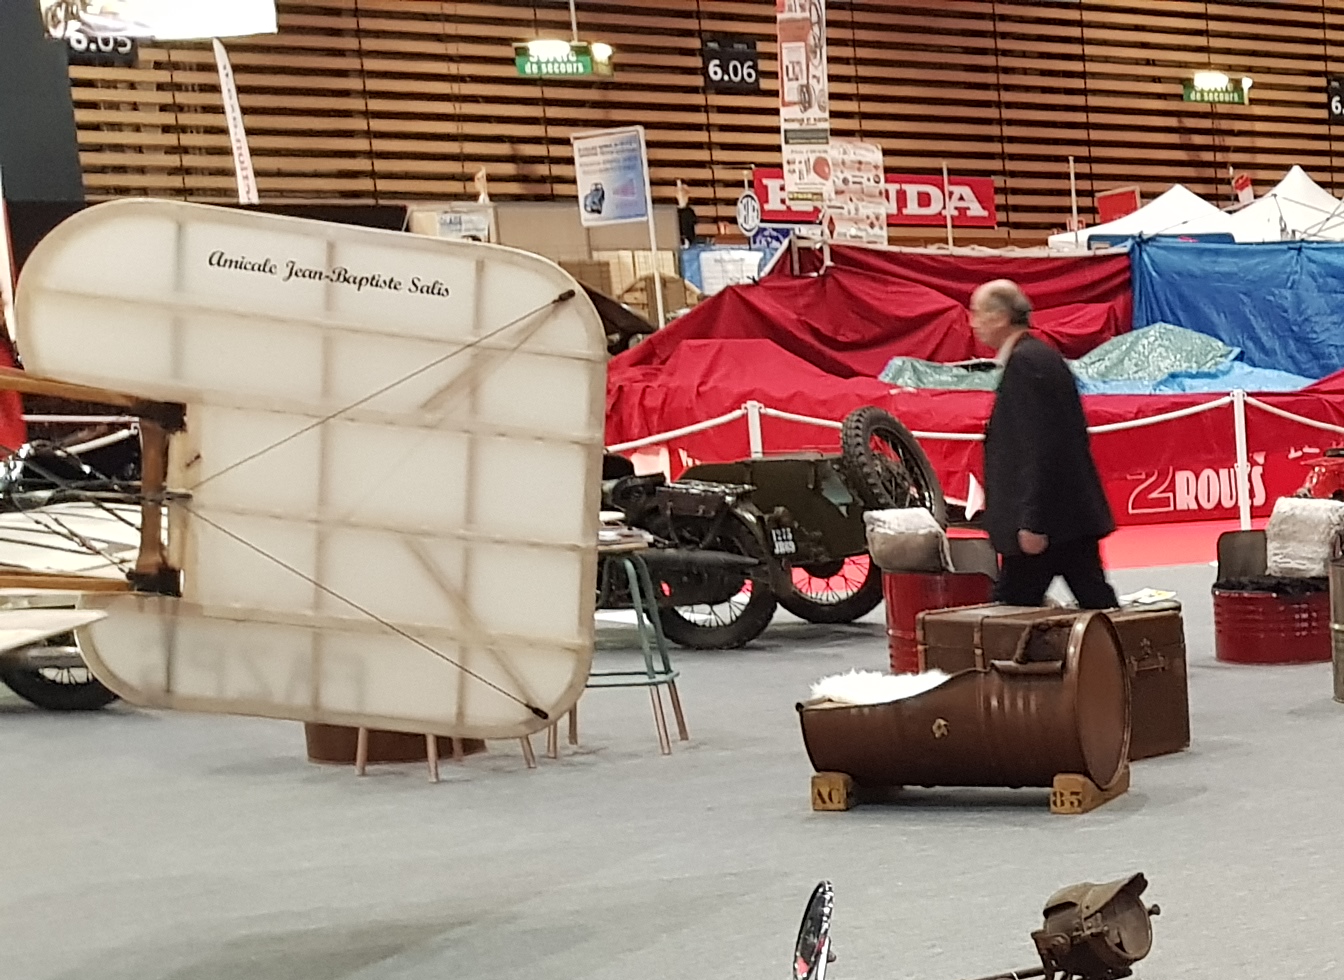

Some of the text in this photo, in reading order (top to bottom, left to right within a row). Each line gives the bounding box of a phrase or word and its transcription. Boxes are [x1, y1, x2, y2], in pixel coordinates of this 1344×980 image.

[541, 61, 585, 74] secours
[707, 60, 757, 83] 6.06
[208, 250, 451, 298] Amicale Jean-Baptiste Salis
[1175, 465, 1267, 511] ROUS
